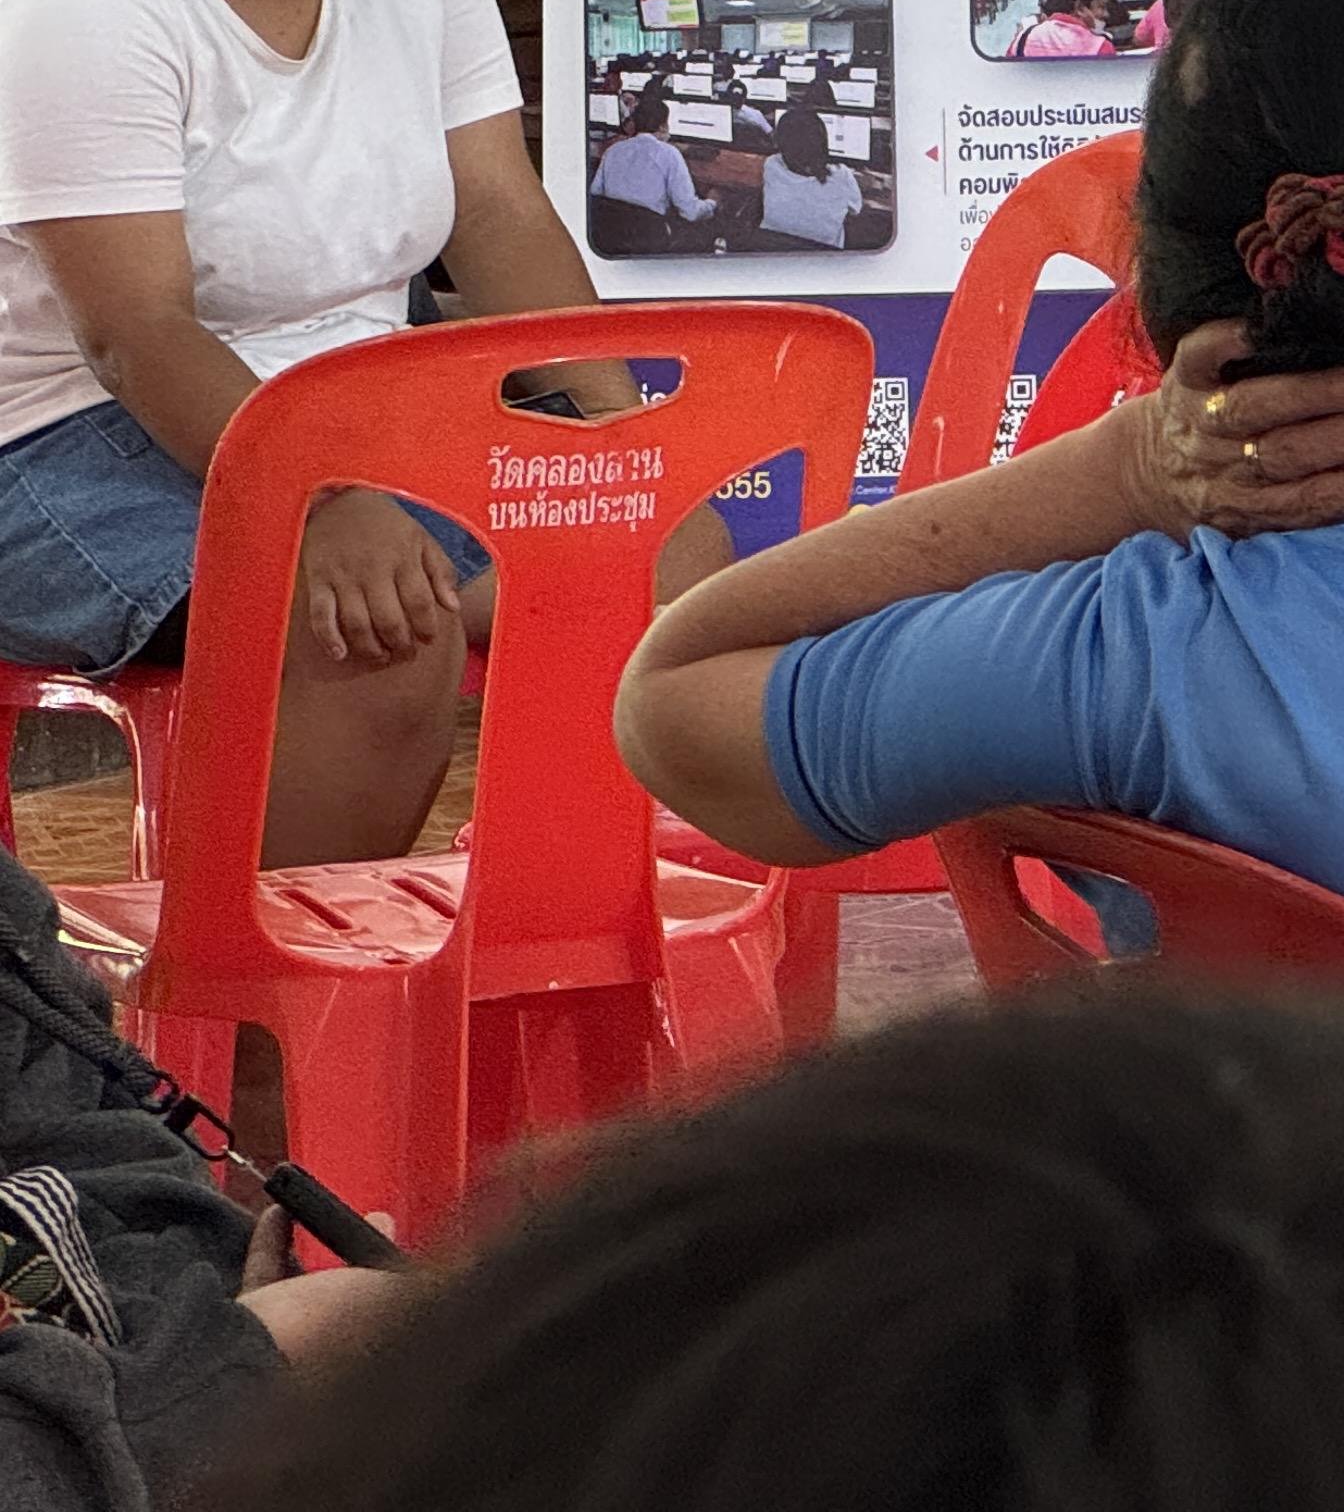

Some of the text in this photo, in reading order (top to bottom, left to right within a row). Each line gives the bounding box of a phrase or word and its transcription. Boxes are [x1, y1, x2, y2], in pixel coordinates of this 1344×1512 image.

[958, 103, 1142, 128] จัดสอบประเมินสมร
[487, 489, 656, 533] บนห้องประชุม
